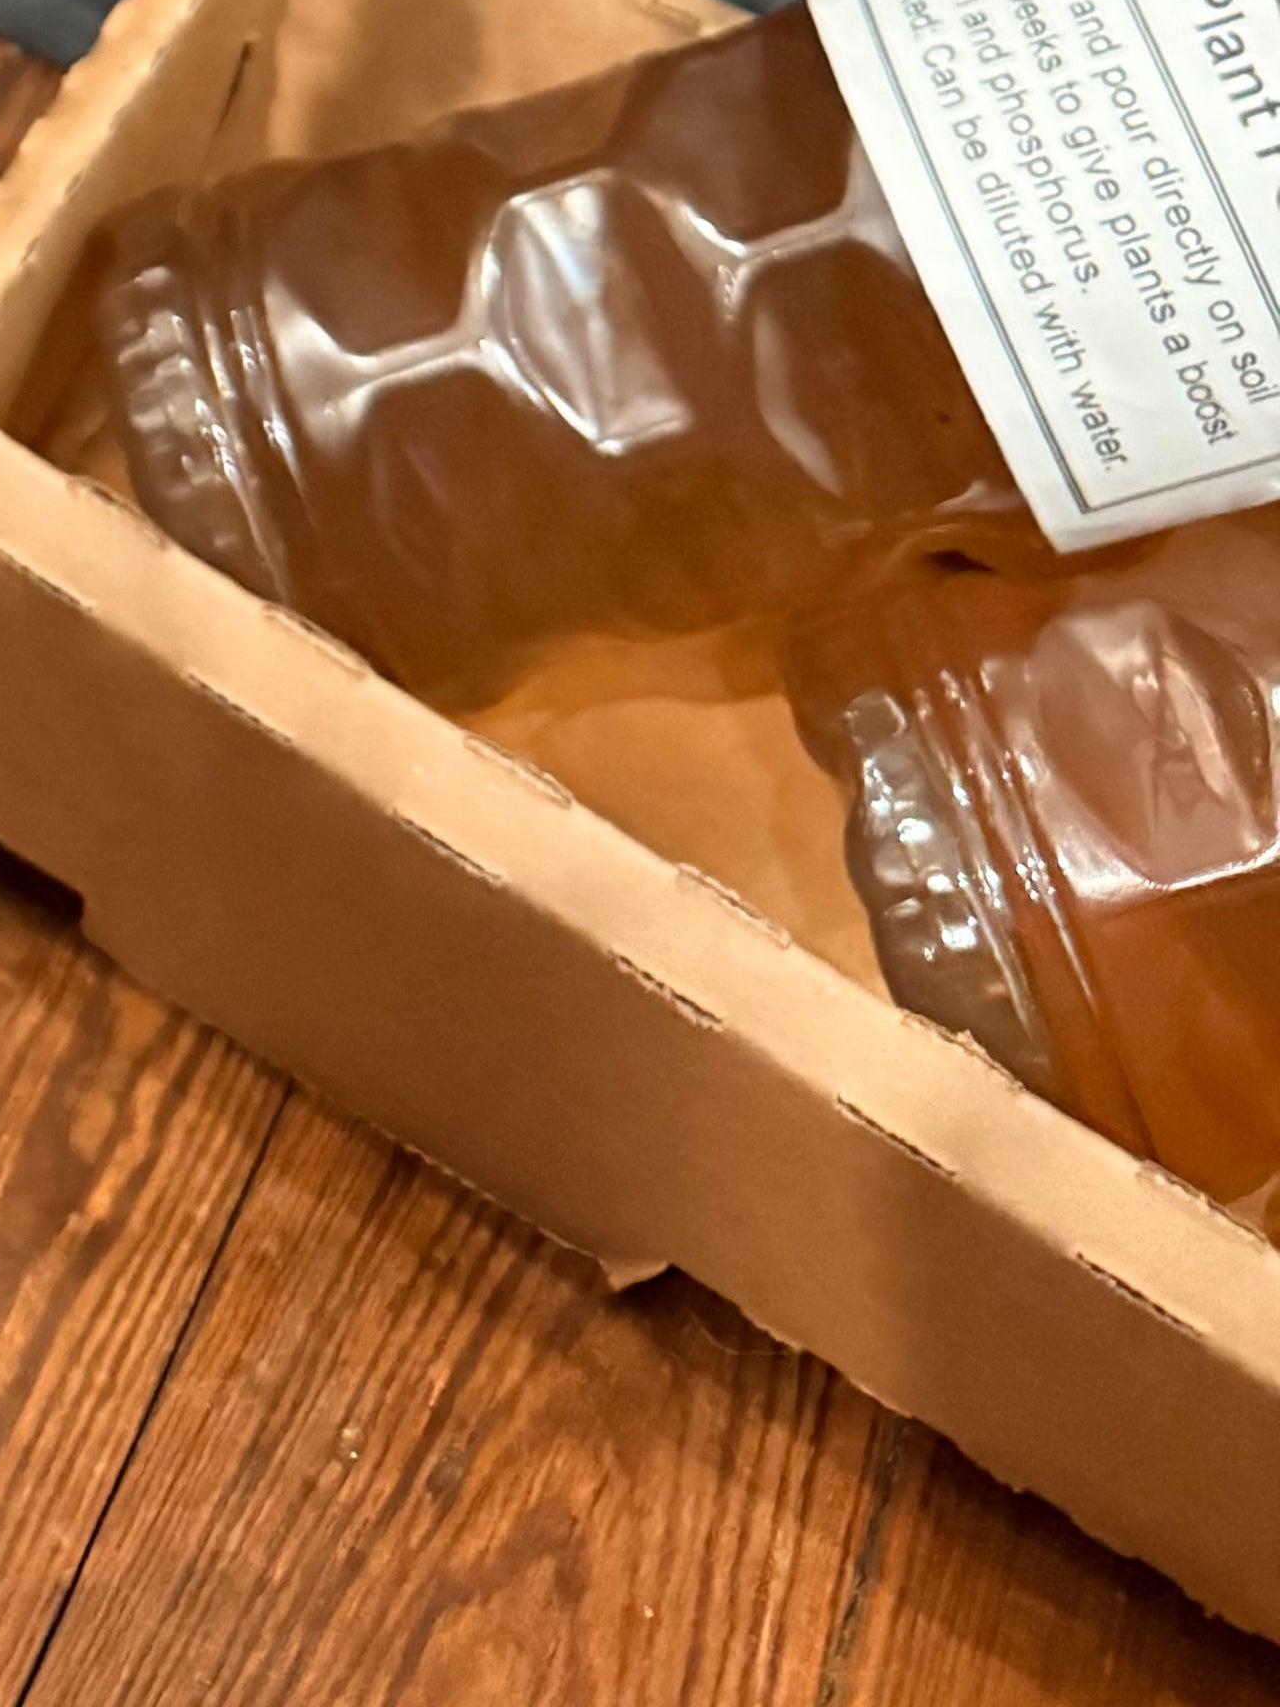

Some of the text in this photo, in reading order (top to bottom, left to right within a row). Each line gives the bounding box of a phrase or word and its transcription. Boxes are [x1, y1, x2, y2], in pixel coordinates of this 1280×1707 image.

[960, 10, 1015, 66] and
[1048, 79, 1084, 117] to
[978, 71, 1102, 296] phosphorus.
[1060, 125, 1122, 204] give
[921, 42, 968, 111] Can
[951, 113, 990, 164] be
[975, 171, 1058, 296] diluted
[1033, 300, 1088, 376] with
[1069, 379, 1130, 472] water.
[1089, 64, 1160, 146] pour
[1141, 156, 1224, 288] directly
[1207, 299, 1247, 346] on
[1230, 351, 1280, 406] soil
[1098, 212, 1178, 326] plants
[1161, 332, 1192, 357] a
[1175, 359, 1240, 447] boost
